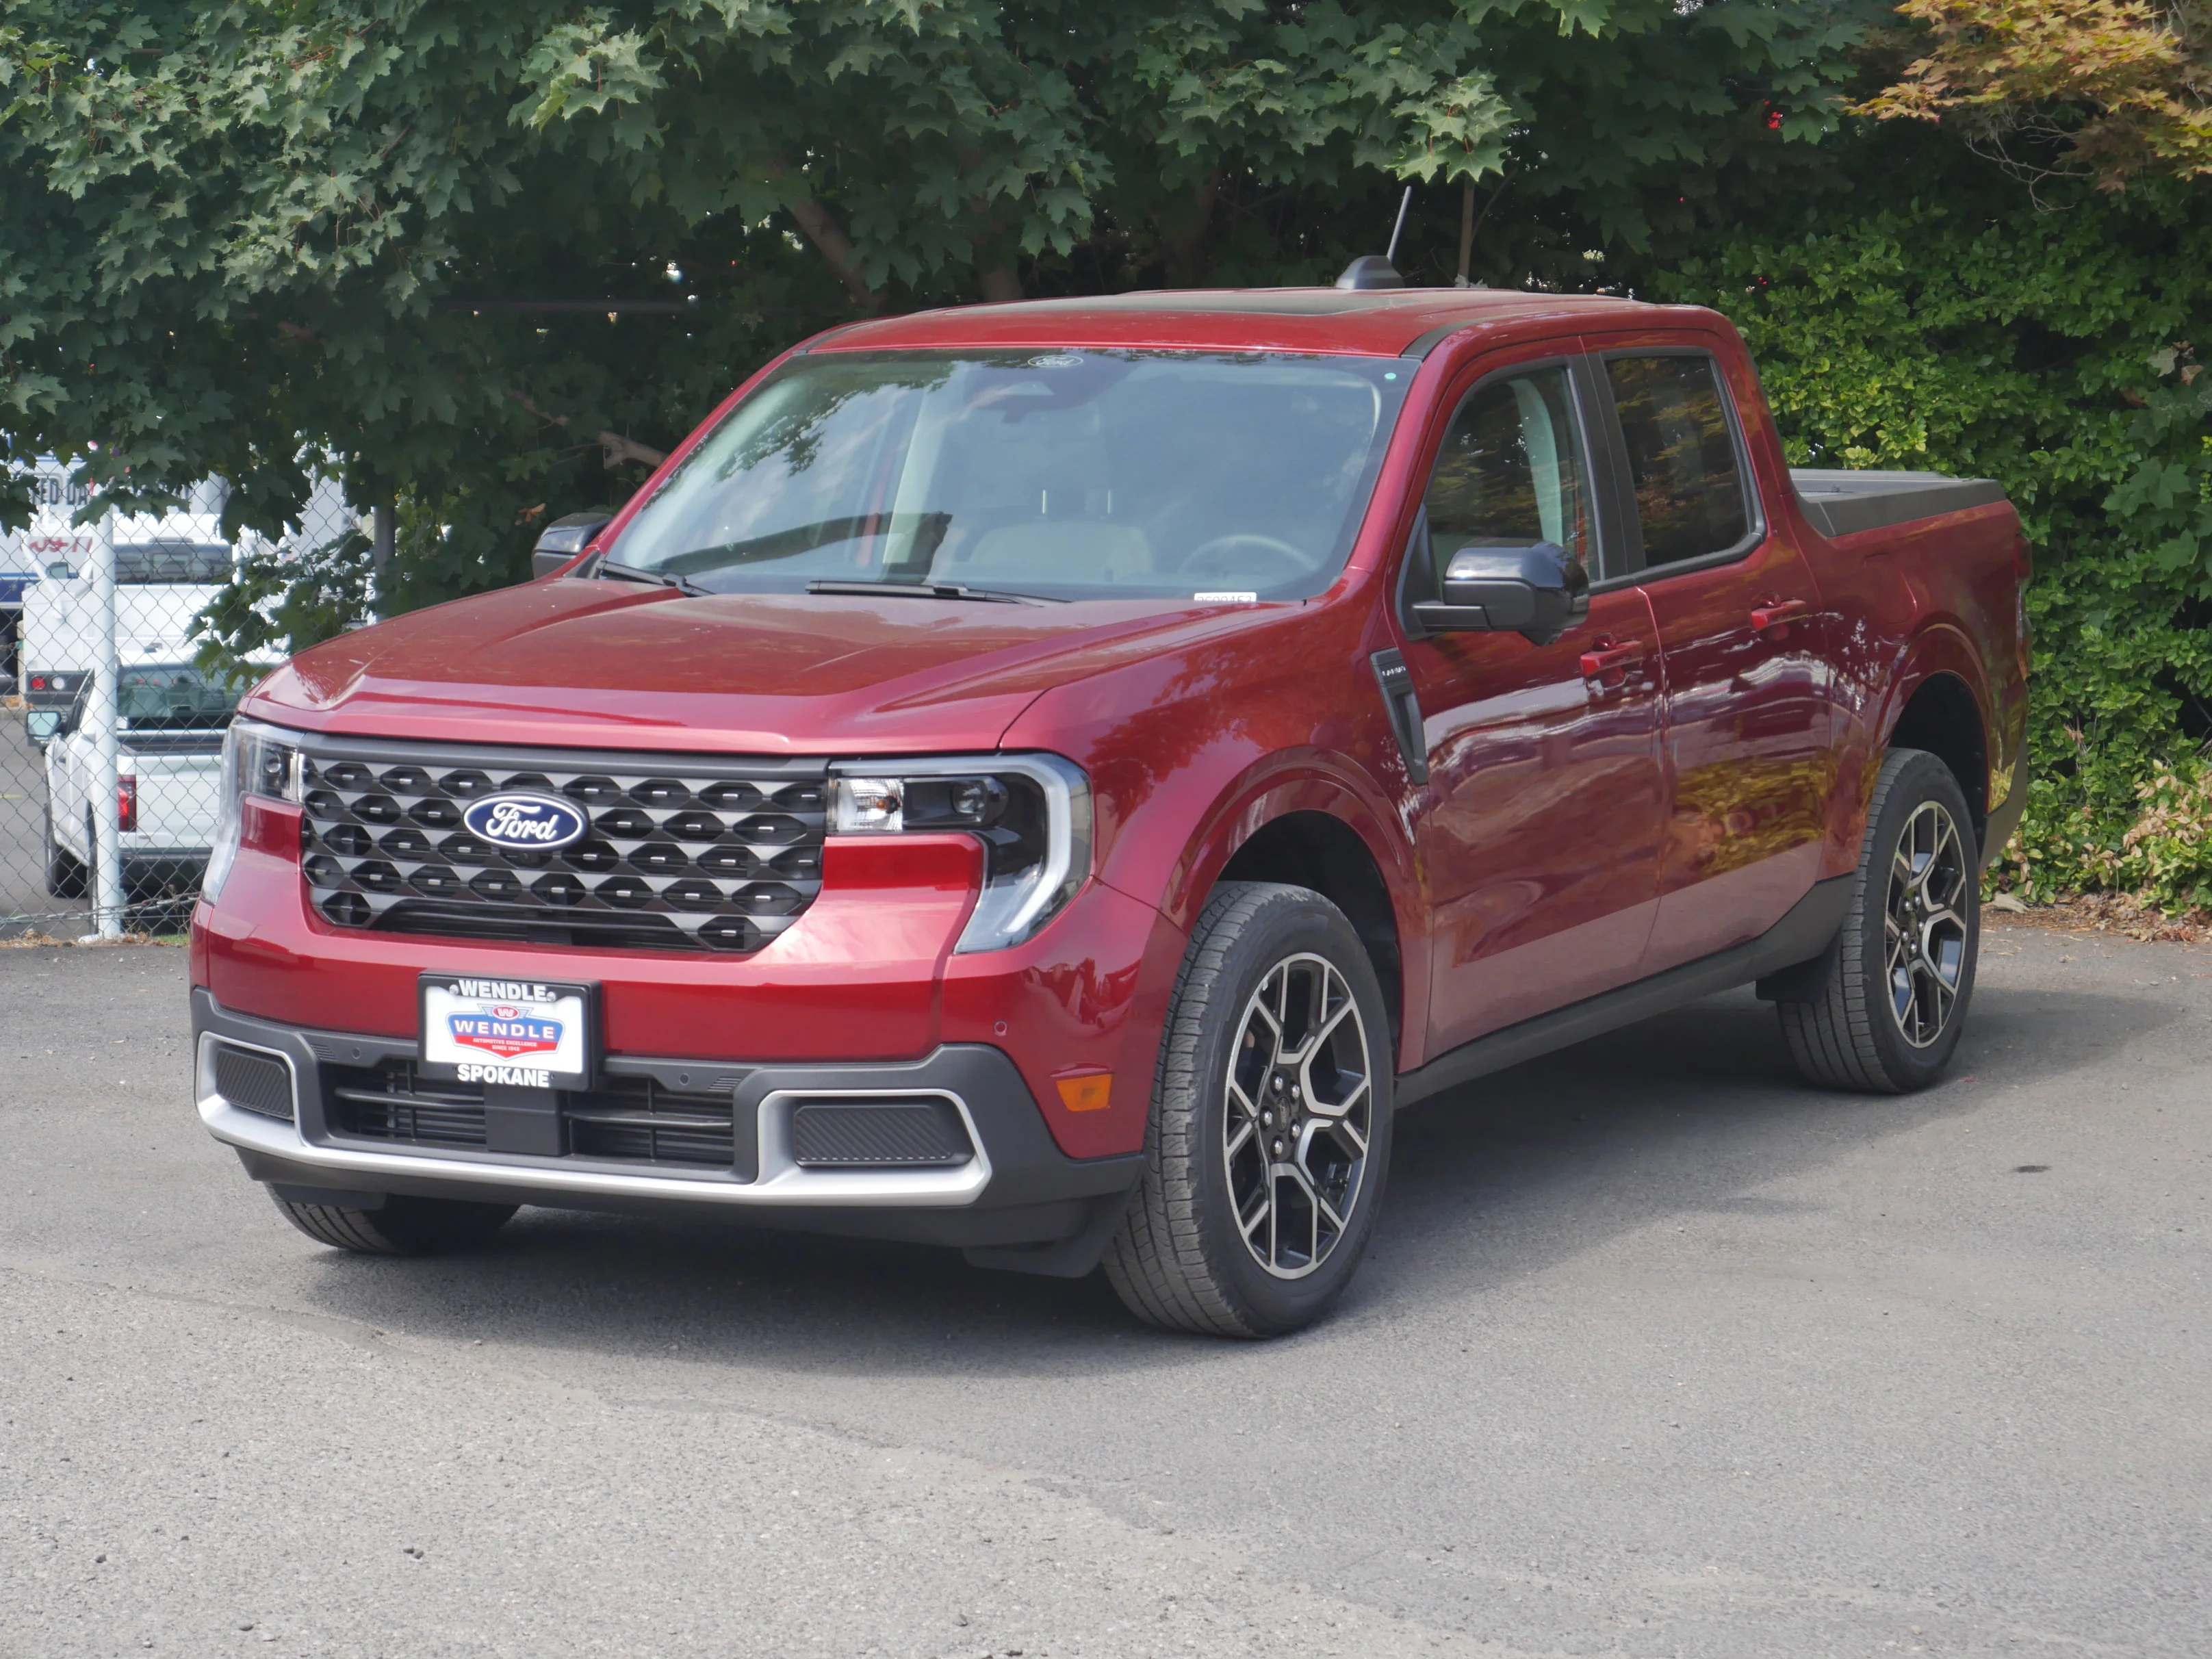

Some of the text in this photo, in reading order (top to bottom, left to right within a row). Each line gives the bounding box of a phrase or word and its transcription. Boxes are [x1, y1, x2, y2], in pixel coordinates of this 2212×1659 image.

[486, 802, 559, 840] Ford
[458, 979, 547, 1001] WENDLE
[454, 1020, 554, 1039] WENDLE
[457, 1064, 550, 1088] SPOKANE
